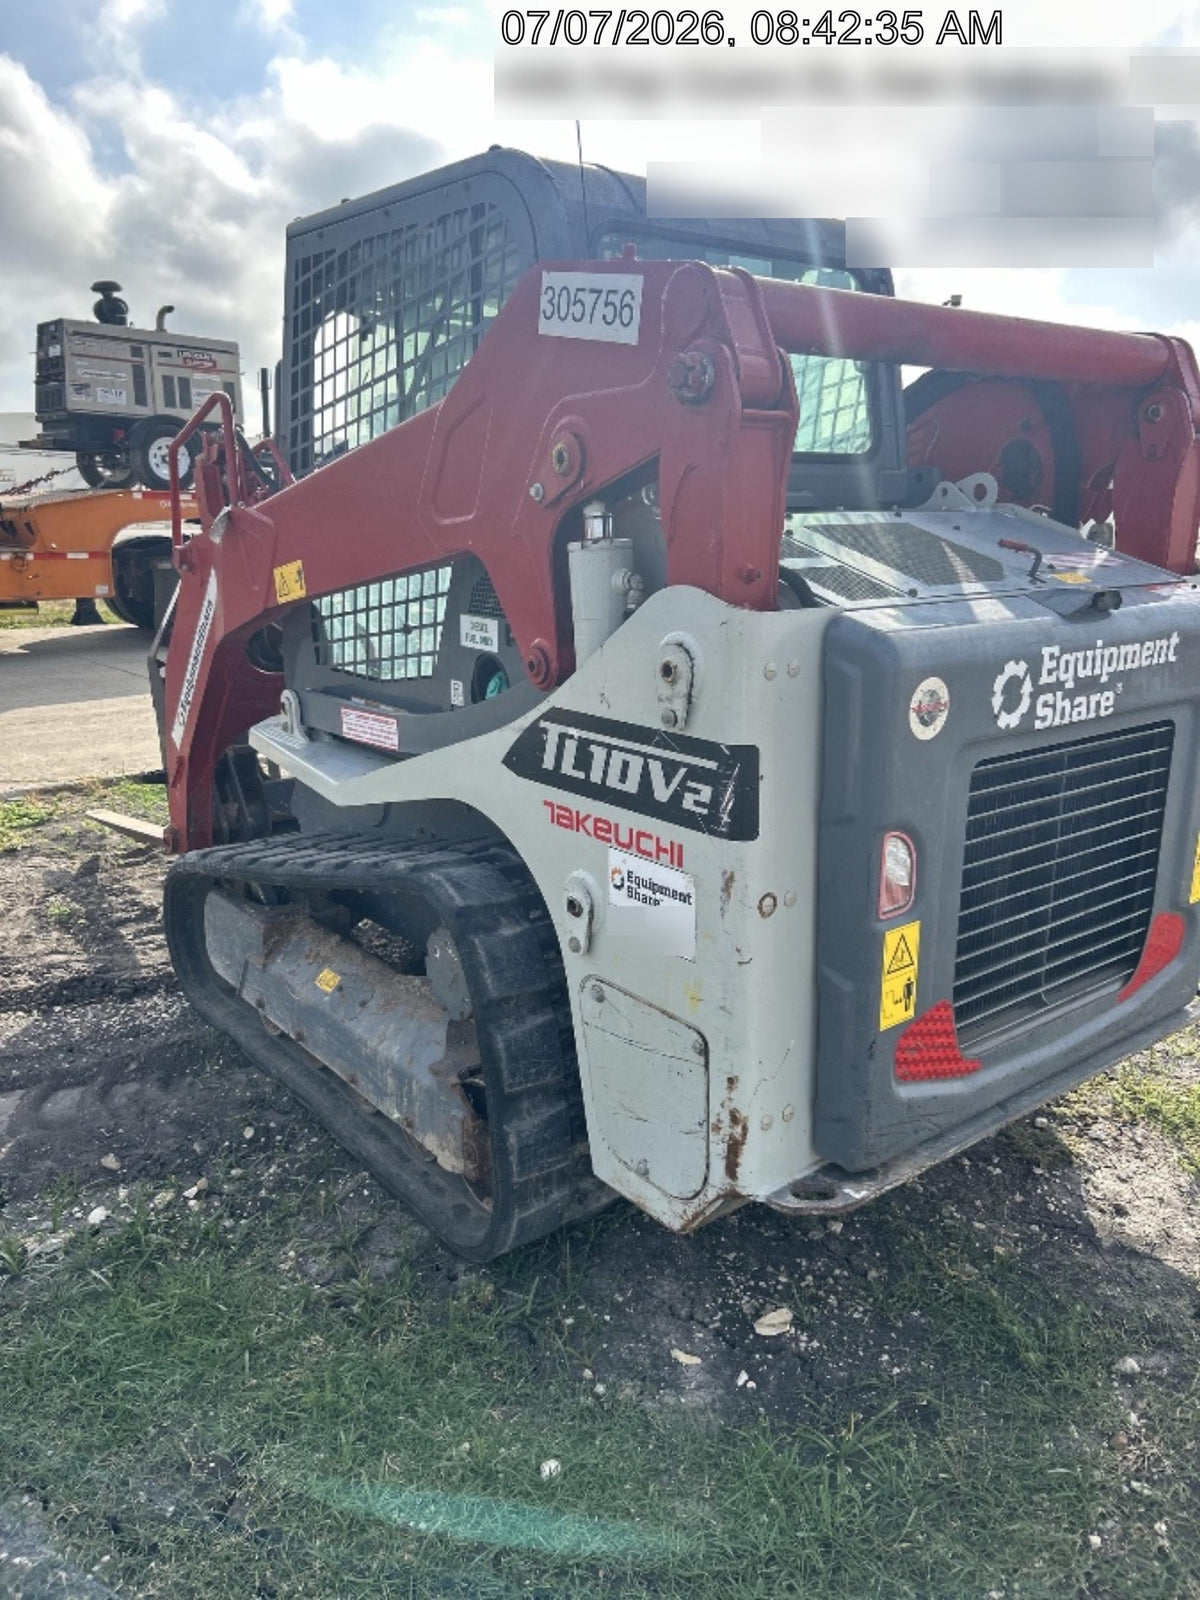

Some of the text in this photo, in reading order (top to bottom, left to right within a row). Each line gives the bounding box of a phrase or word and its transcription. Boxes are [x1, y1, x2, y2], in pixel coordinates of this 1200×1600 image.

[542, 286, 635, 327] 305756
[1039, 631, 1180, 688] Equipment
[1035, 689, 1115, 730] Share
[626, 869, 693, 906] Equipment
[626, 884, 661, 907] Share
